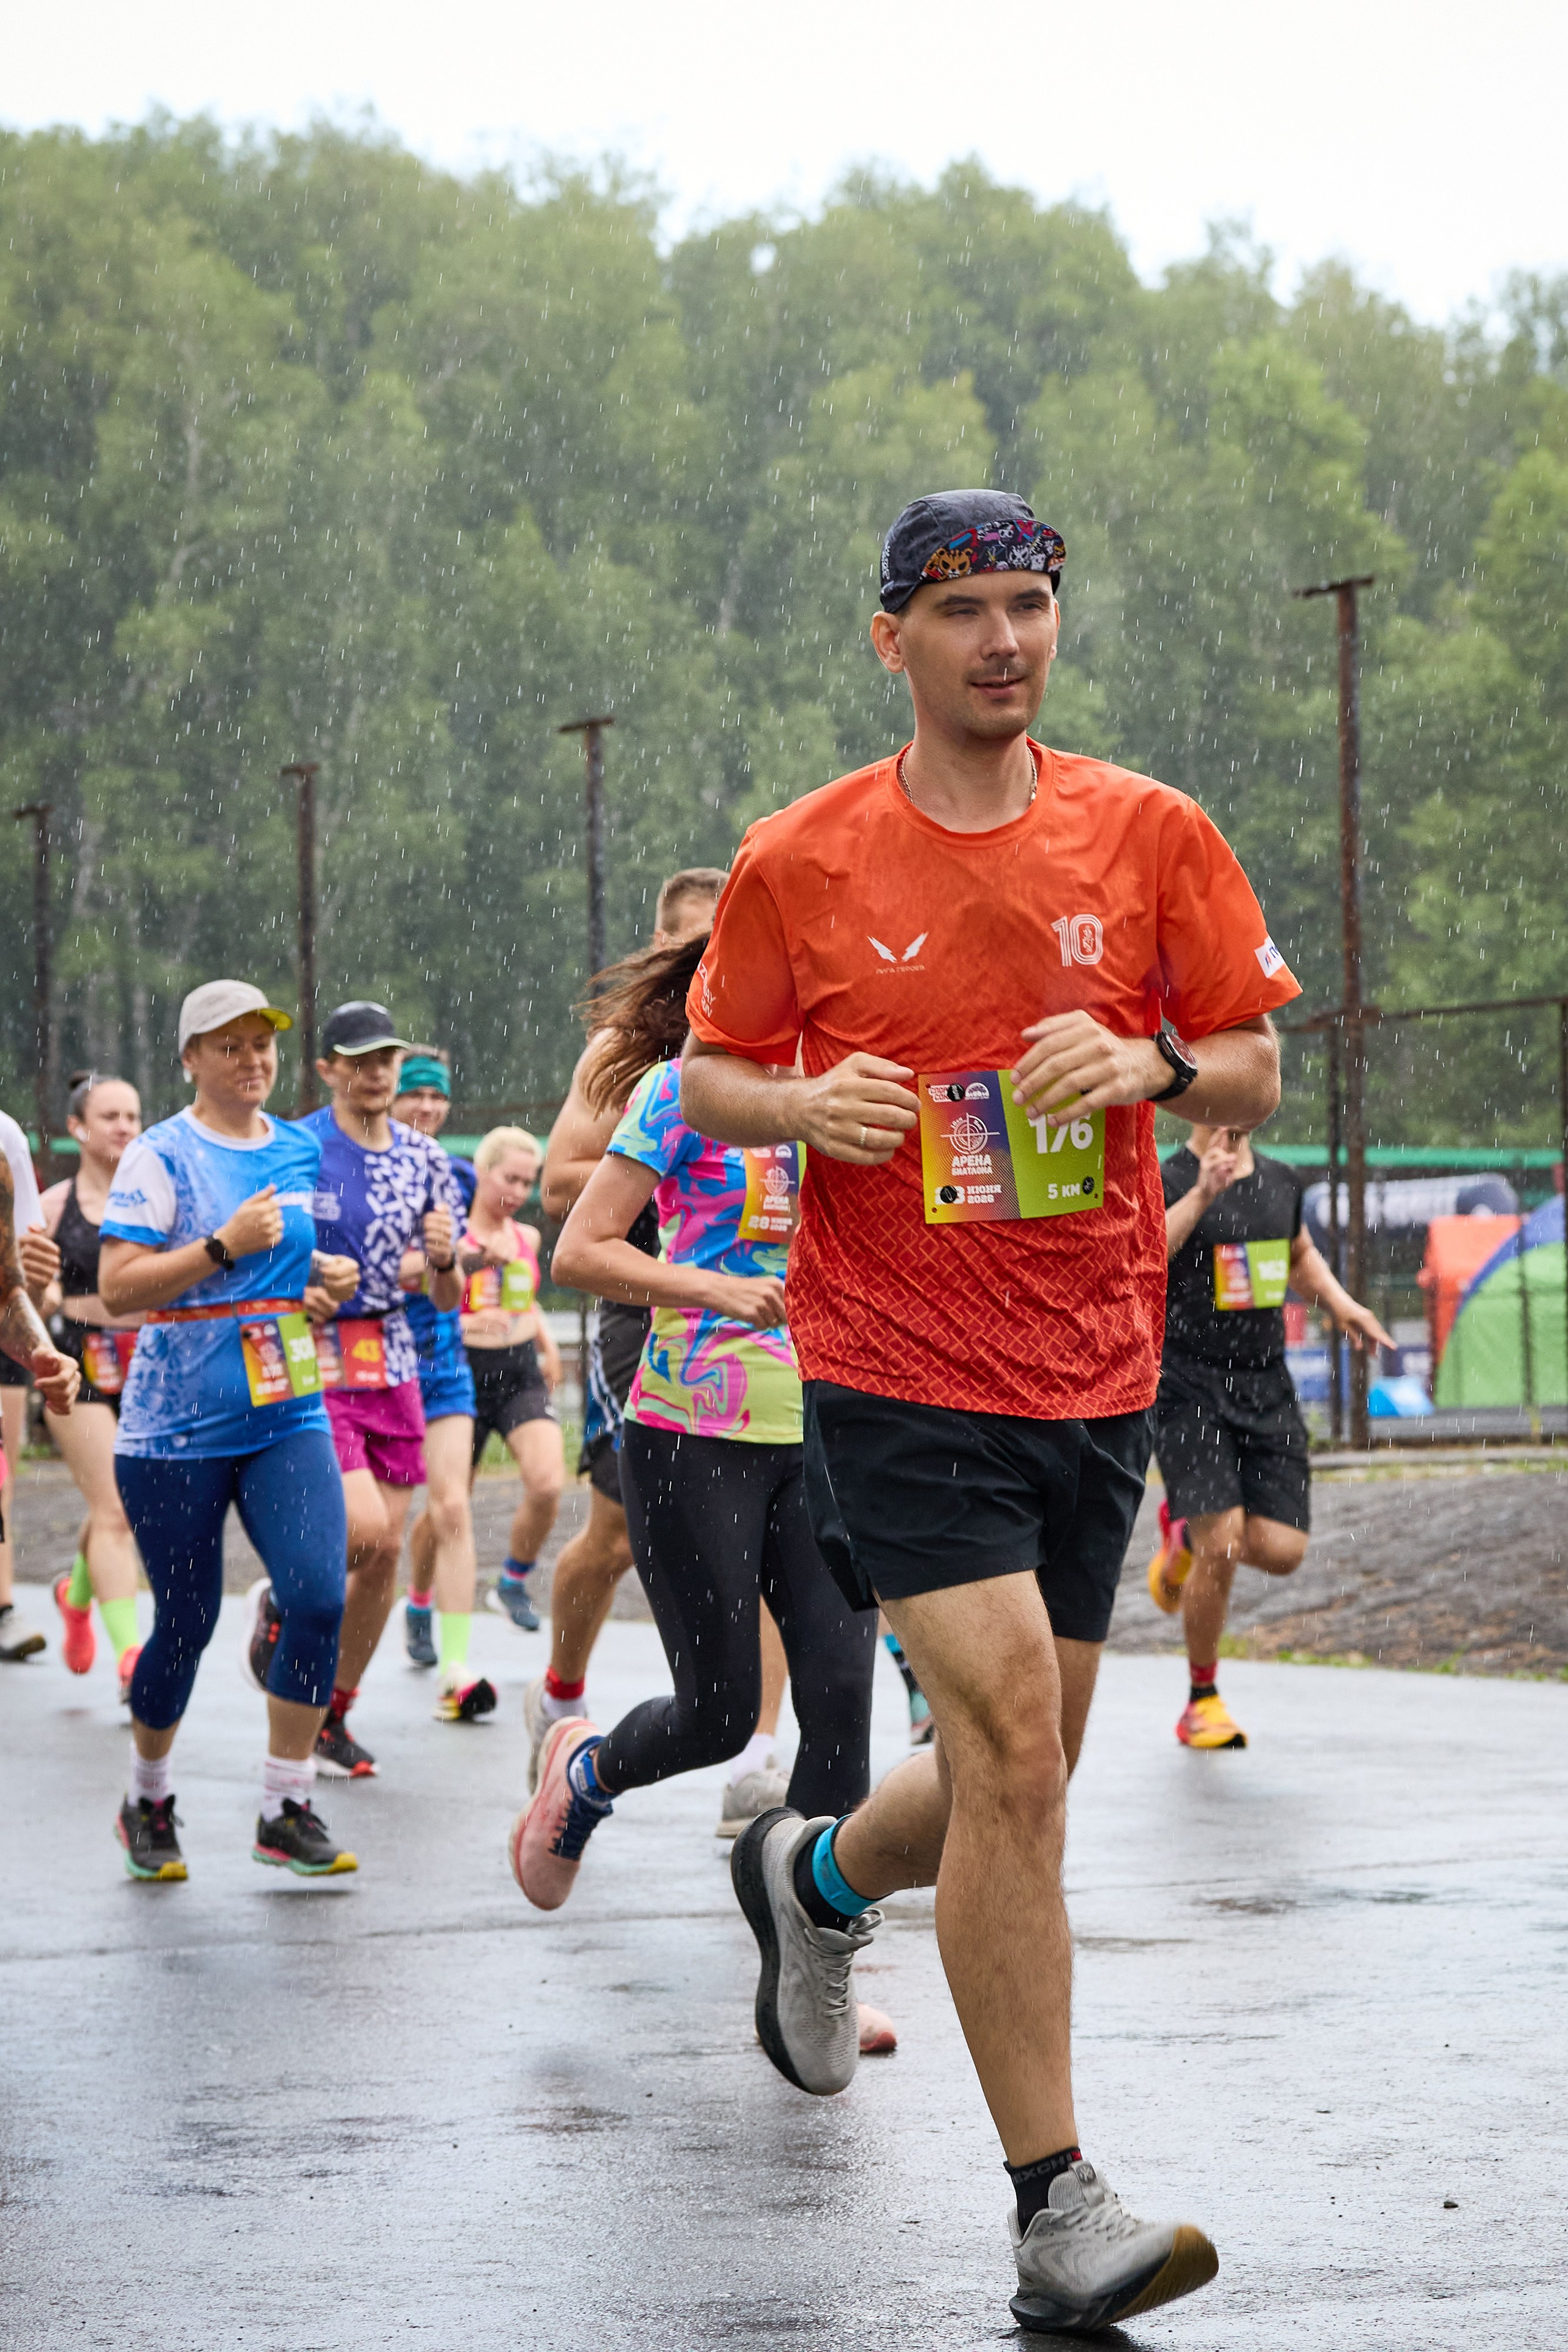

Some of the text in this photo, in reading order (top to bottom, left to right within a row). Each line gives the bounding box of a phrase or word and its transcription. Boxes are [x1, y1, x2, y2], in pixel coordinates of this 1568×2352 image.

[1050, 914, 1103, 967] 10
[1027, 1114, 1094, 1154] 176
[952, 1154, 992, 1167] АРЕНА
[1047, 1183, 1058, 1199] 5
